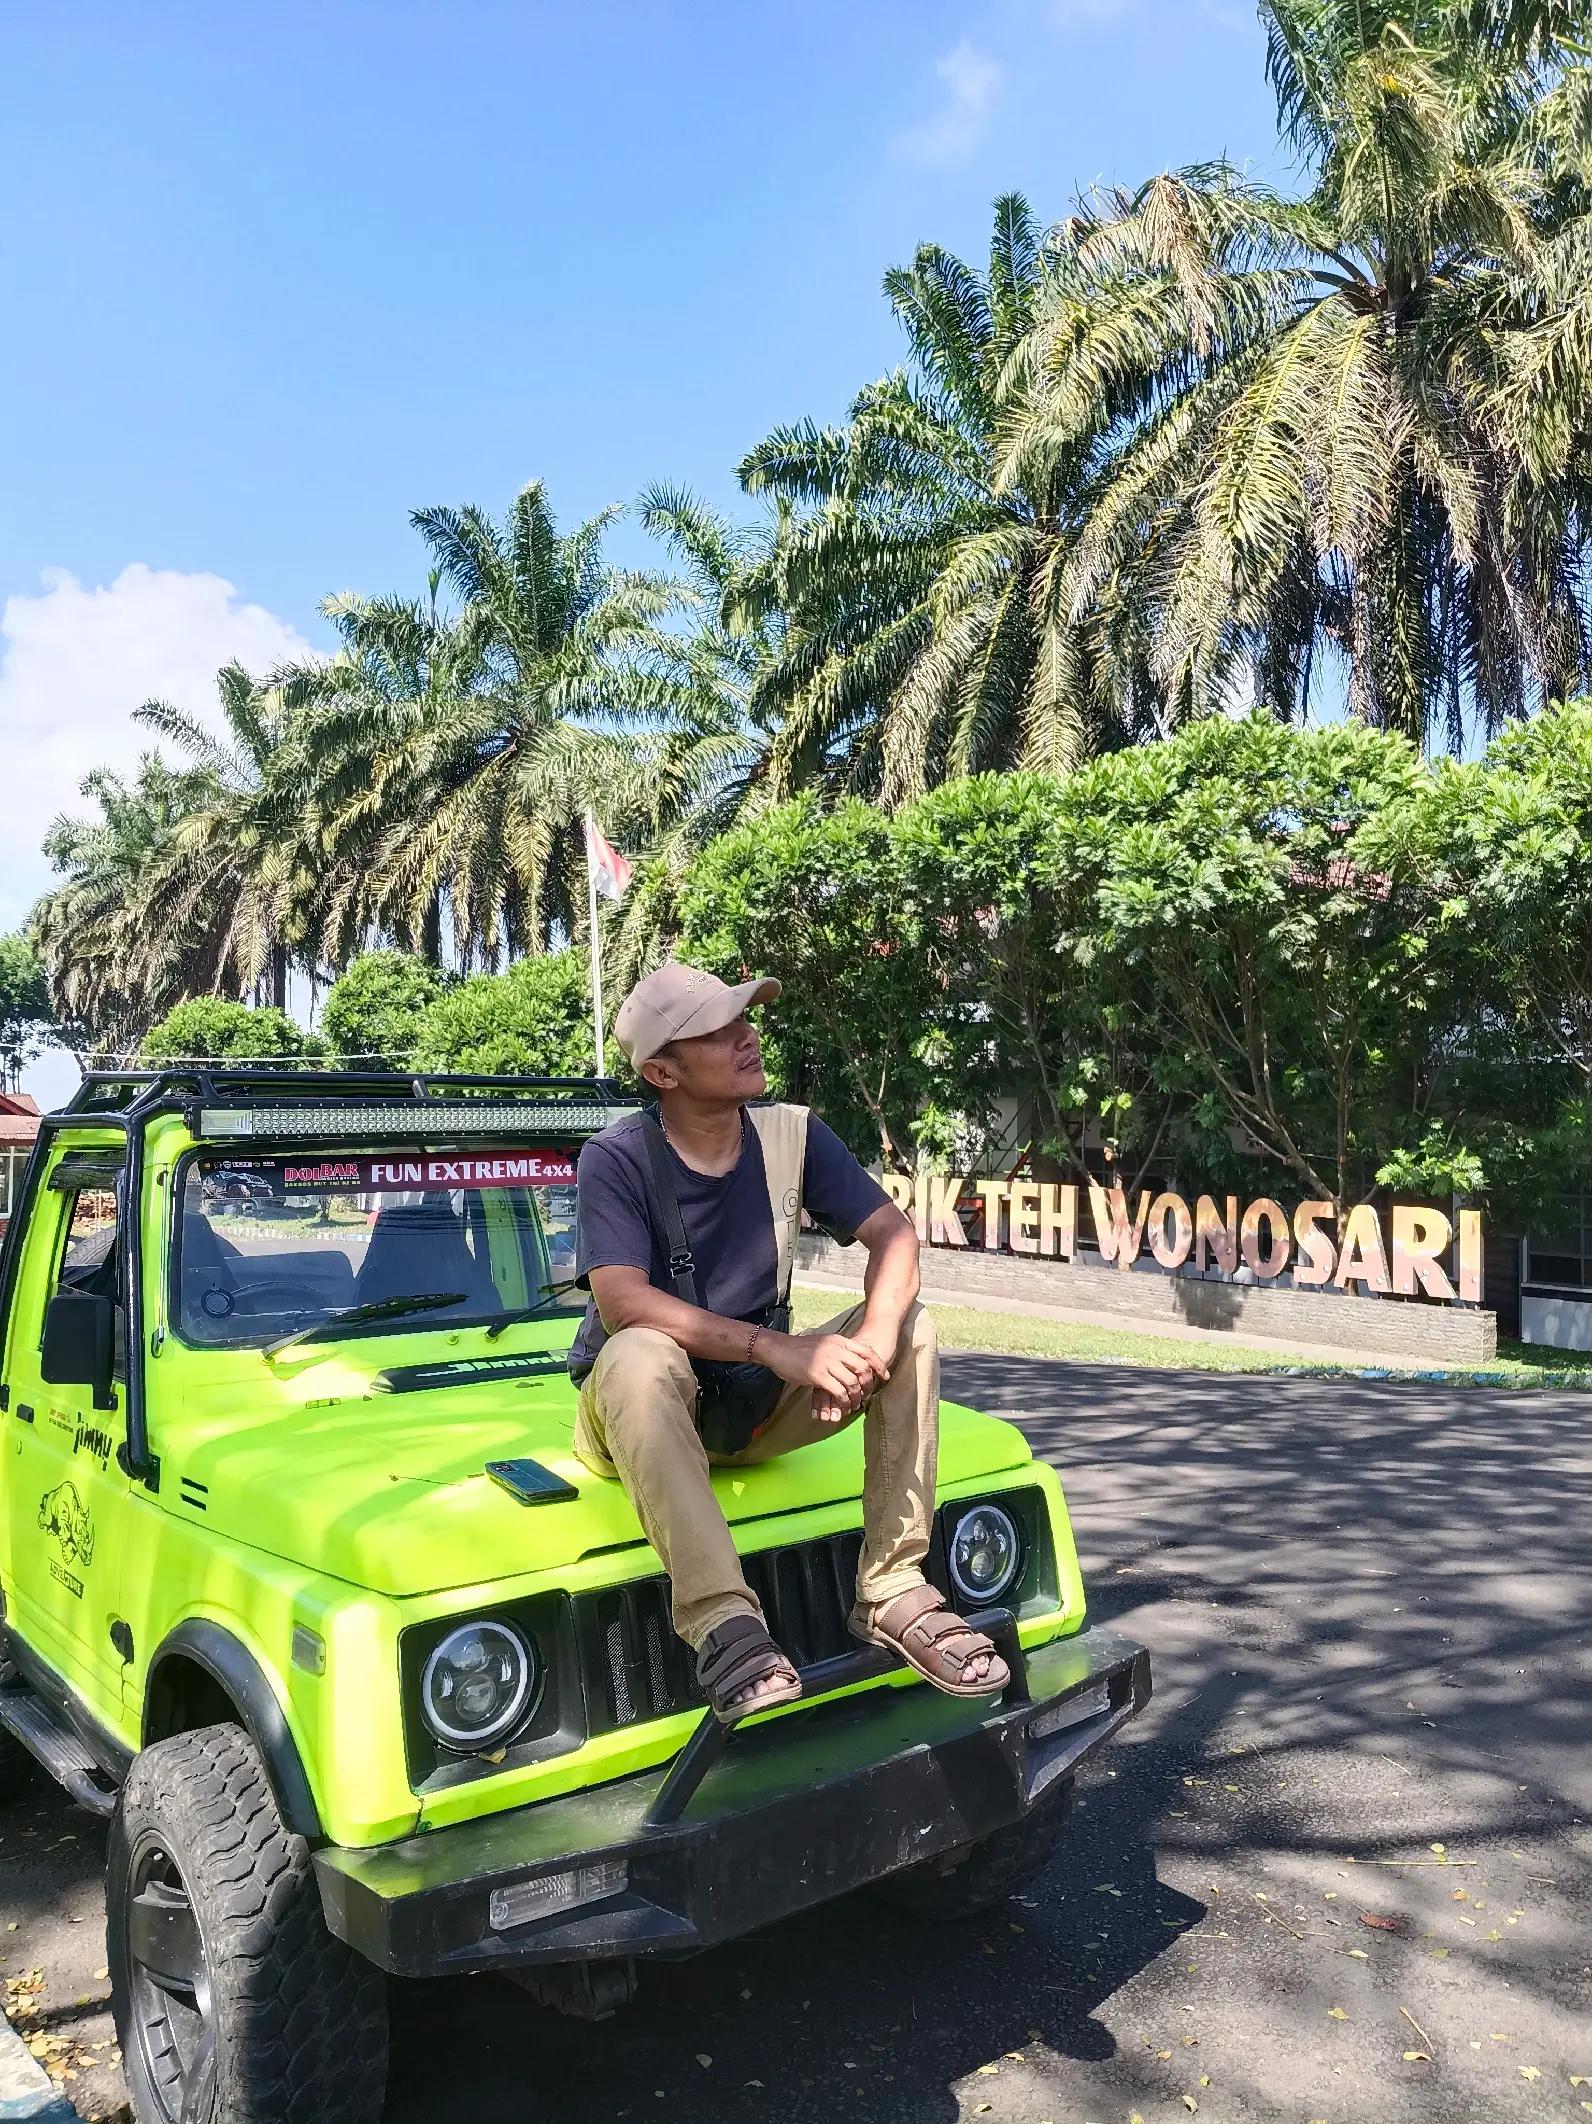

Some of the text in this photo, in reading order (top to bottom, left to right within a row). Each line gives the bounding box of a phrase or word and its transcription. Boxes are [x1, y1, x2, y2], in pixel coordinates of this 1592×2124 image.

[284, 1163, 360, 1182] DOLBAR
[371, 1158, 574, 1183] FUN EXTREME 4X4
[868, 1172, 970, 1246] RIK
[976, 1180, 1079, 1257] TEH
[1088, 1187, 1485, 1303] WONOSARI
